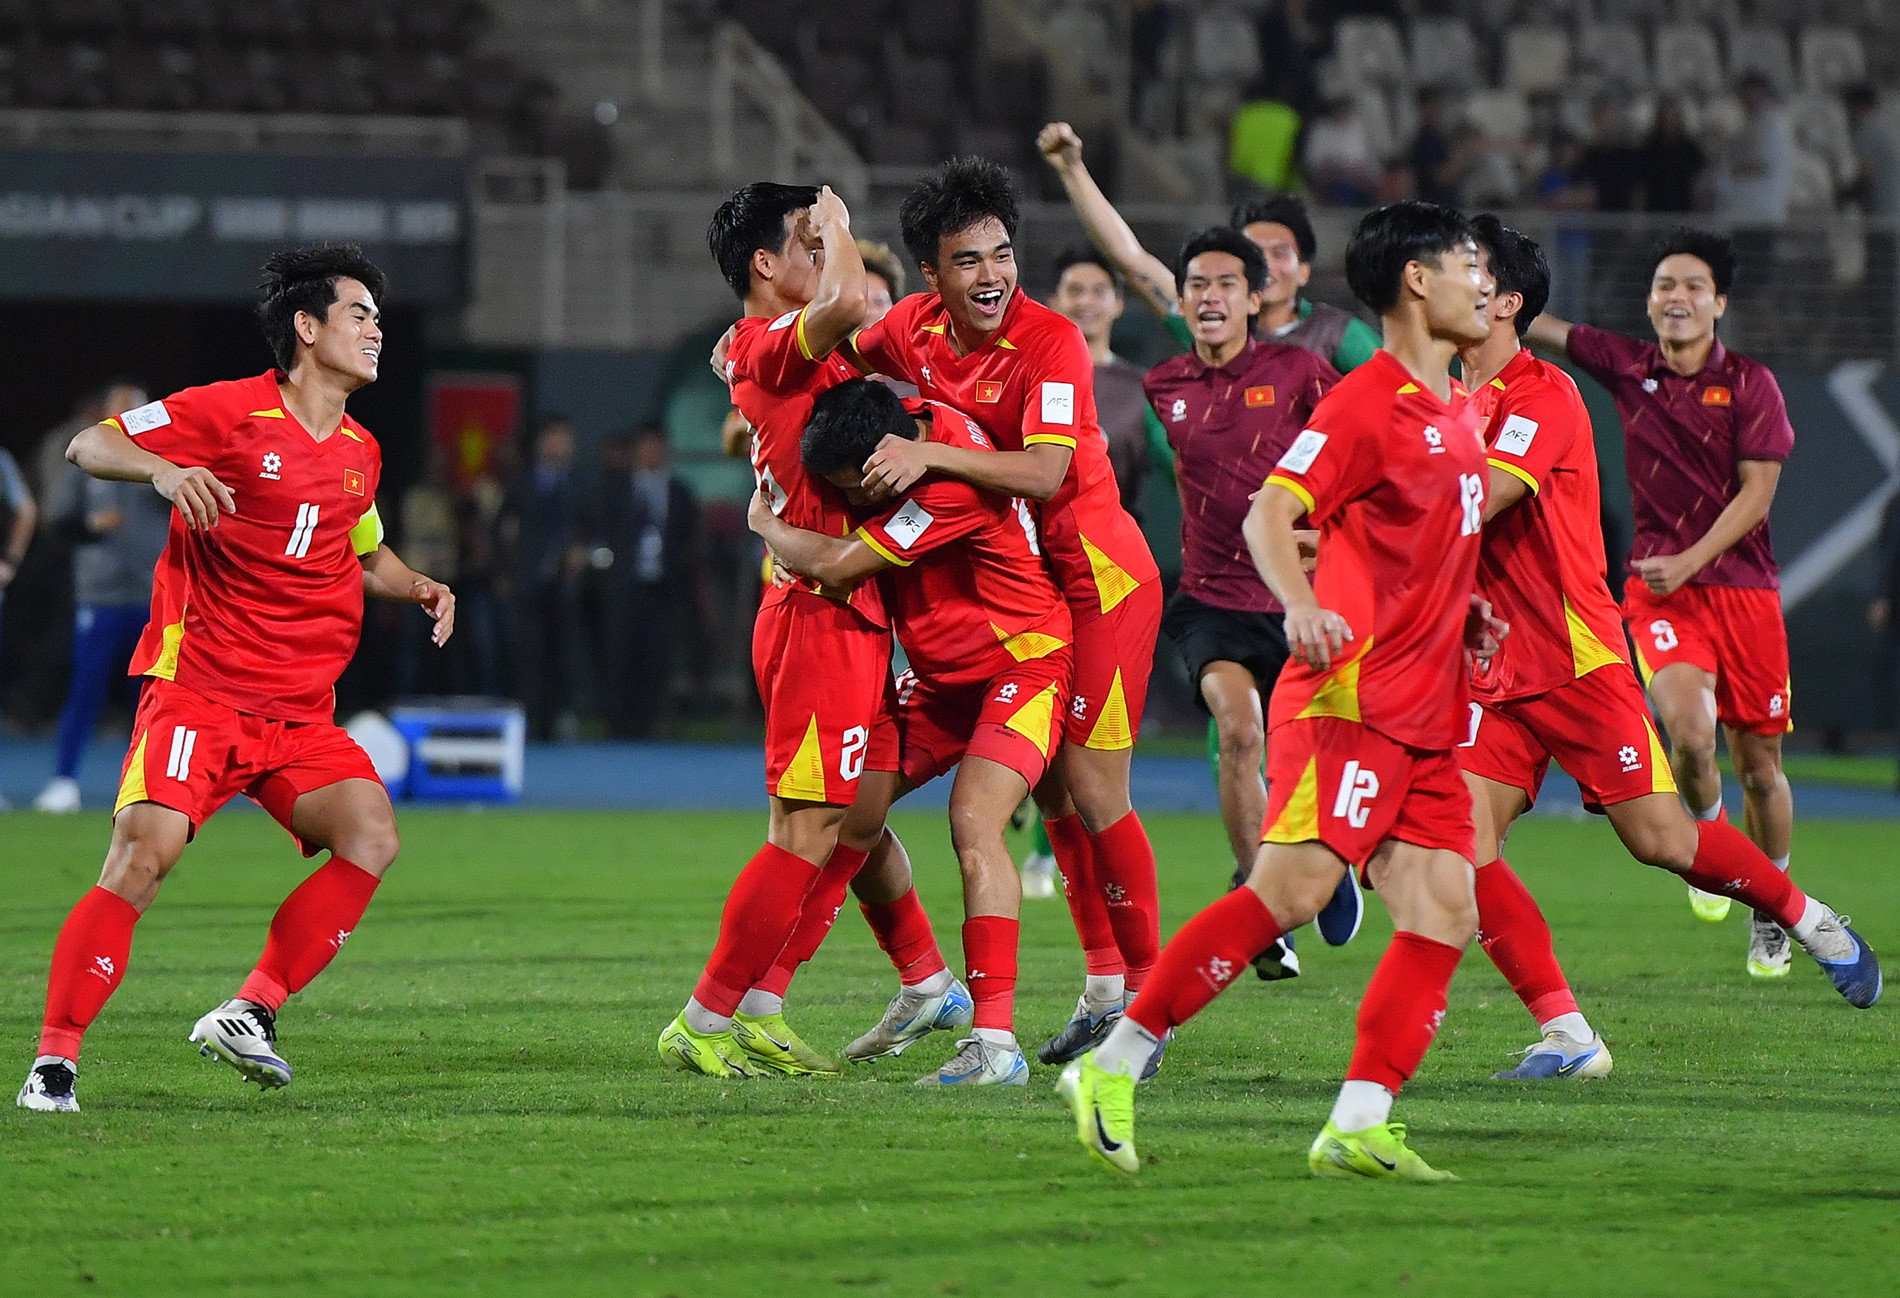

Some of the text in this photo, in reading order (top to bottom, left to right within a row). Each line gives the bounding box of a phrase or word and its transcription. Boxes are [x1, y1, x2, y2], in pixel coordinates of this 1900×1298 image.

[1046, 397, 1069, 407] AFC
[1505, 429, 1528, 442] AFC
[285, 503, 320, 558] 11
[898, 516, 920, 533] AFC
[1459, 473, 1484, 537] 12
[166, 726, 197, 781] 11
[840, 725, 869, 782] 2
[1332, 760, 1380, 829] 12
